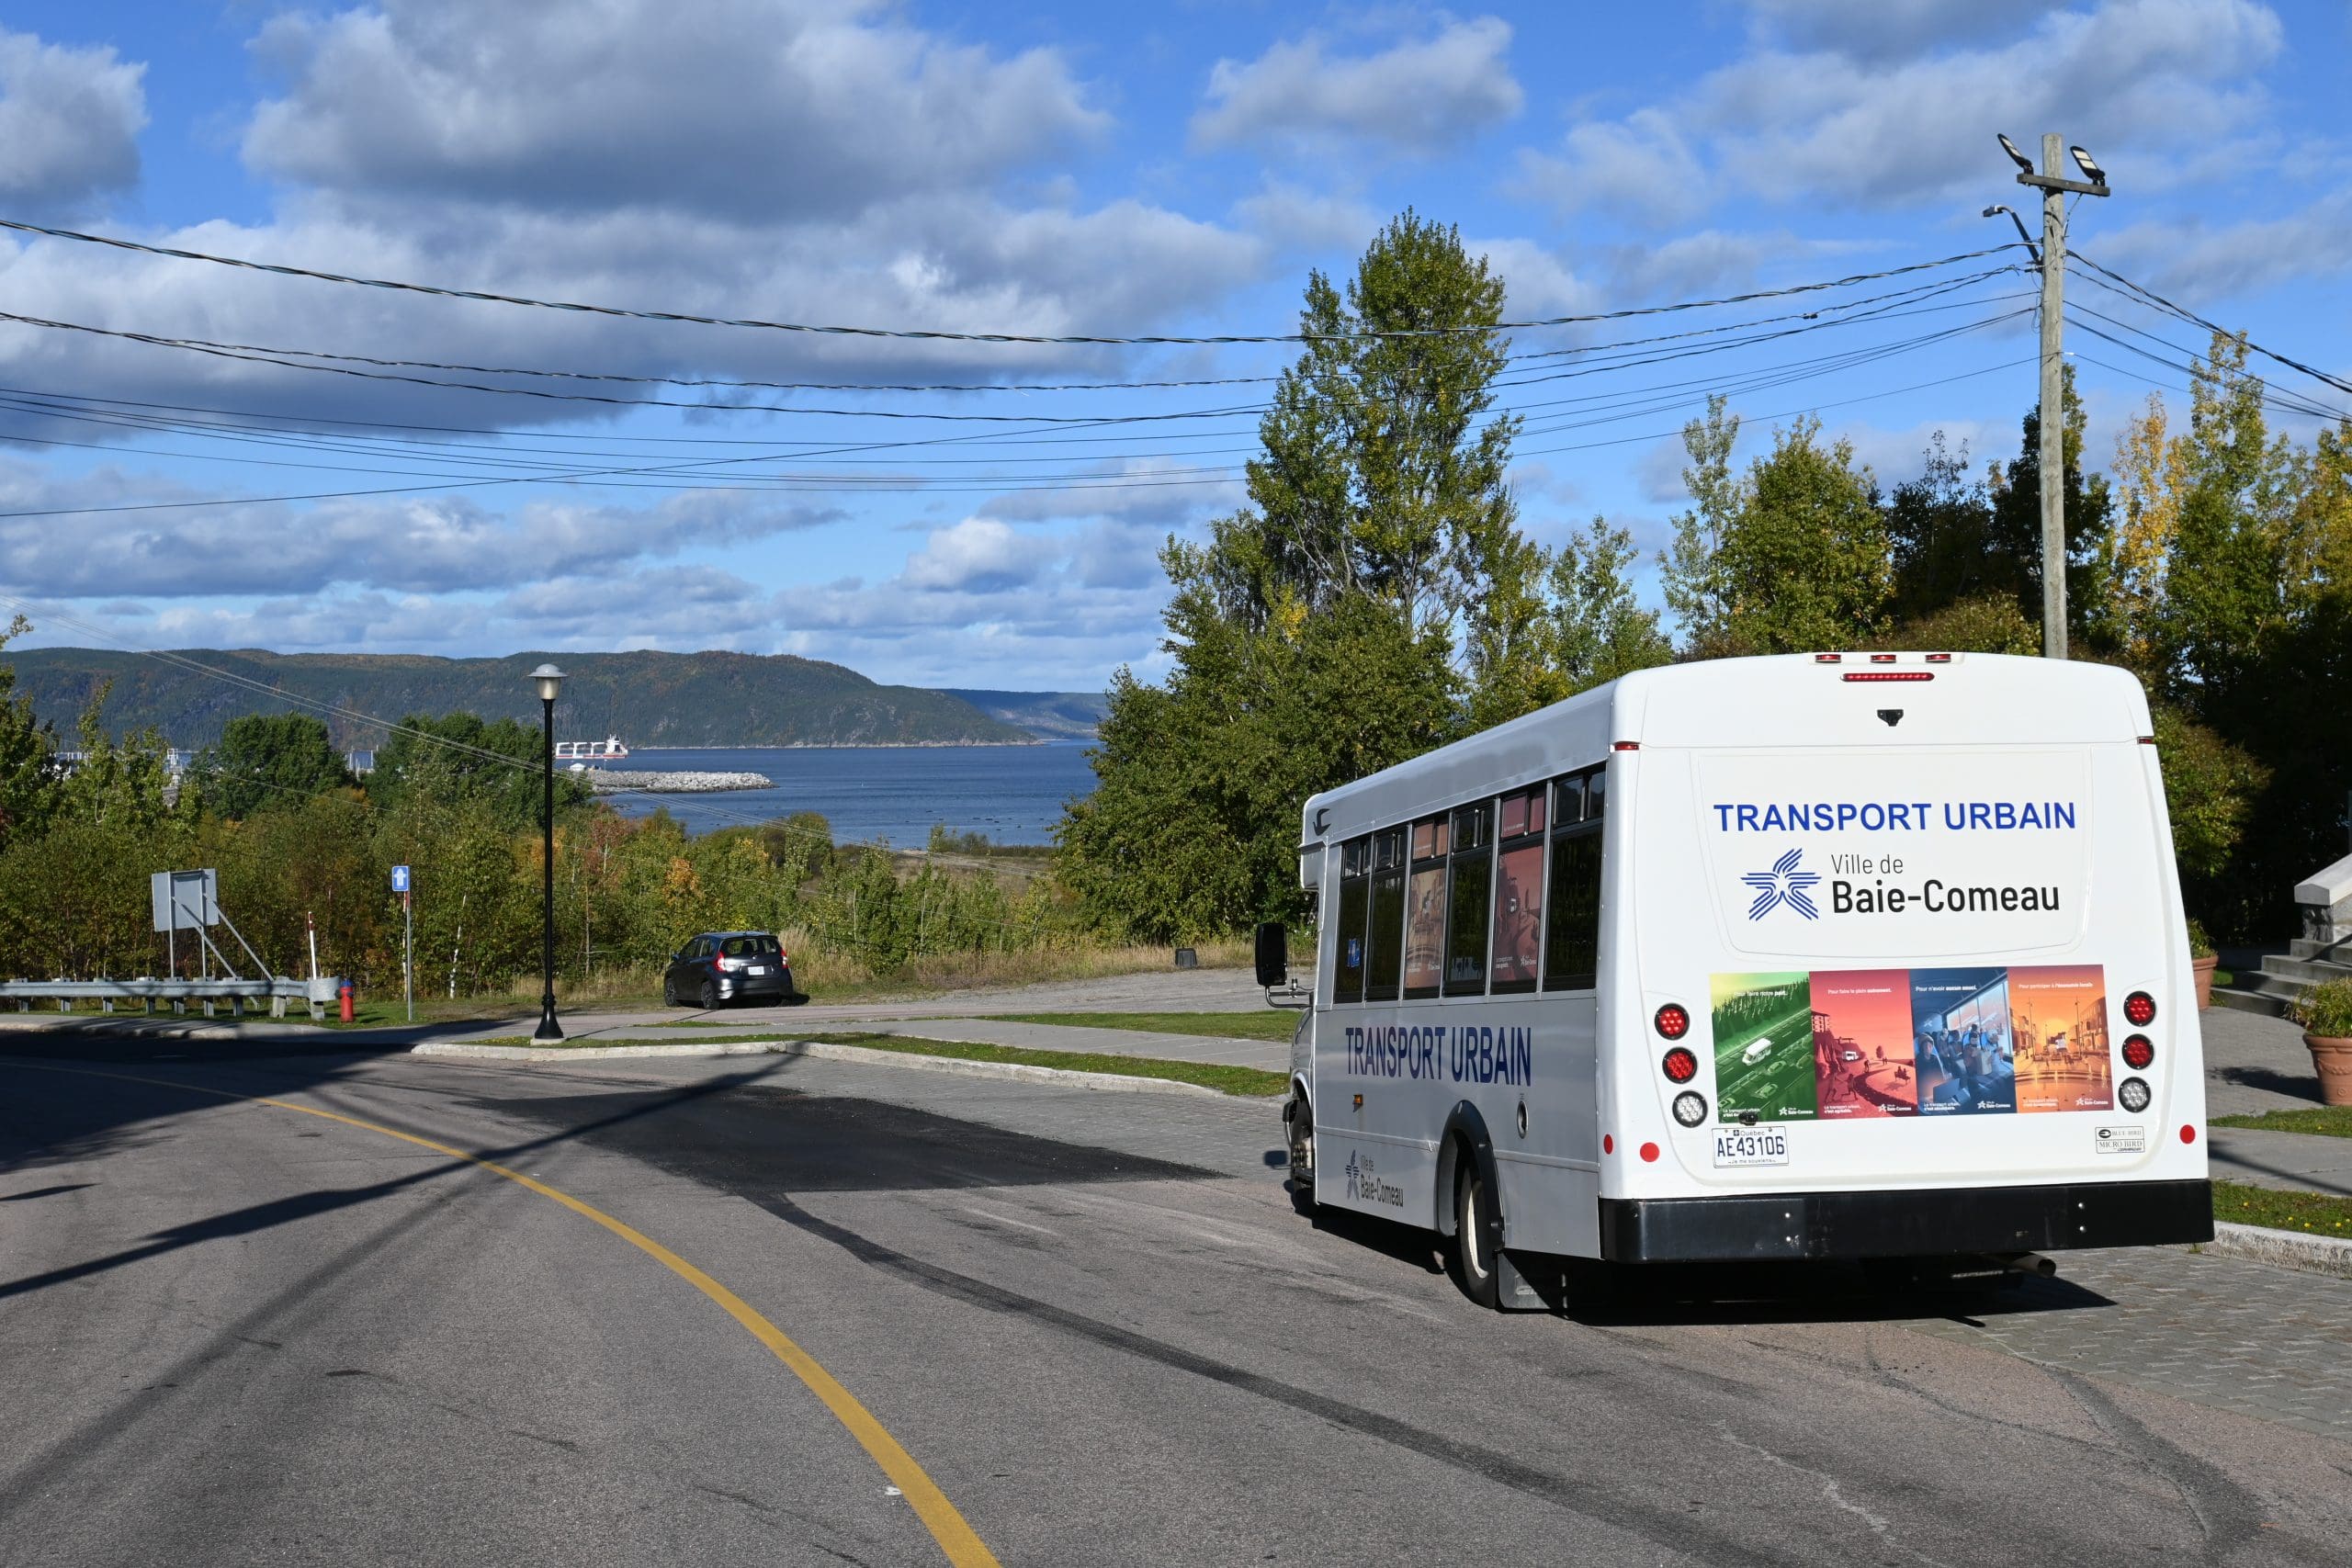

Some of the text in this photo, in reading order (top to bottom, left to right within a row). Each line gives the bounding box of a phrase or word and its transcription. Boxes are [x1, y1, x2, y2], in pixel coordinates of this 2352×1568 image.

[1713, 802, 2075, 831] TRANSPORT URBAIN
[1831, 853, 1904, 874] Ville de
[1832, 879, 2060, 913] Baie-Comeau
[1345, 1026, 1532, 1087] TRANSPORT URBAIN
[1717, 1136, 1785, 1156] AE43106
[1361, 1173, 1404, 1207] Baie-Comeau
